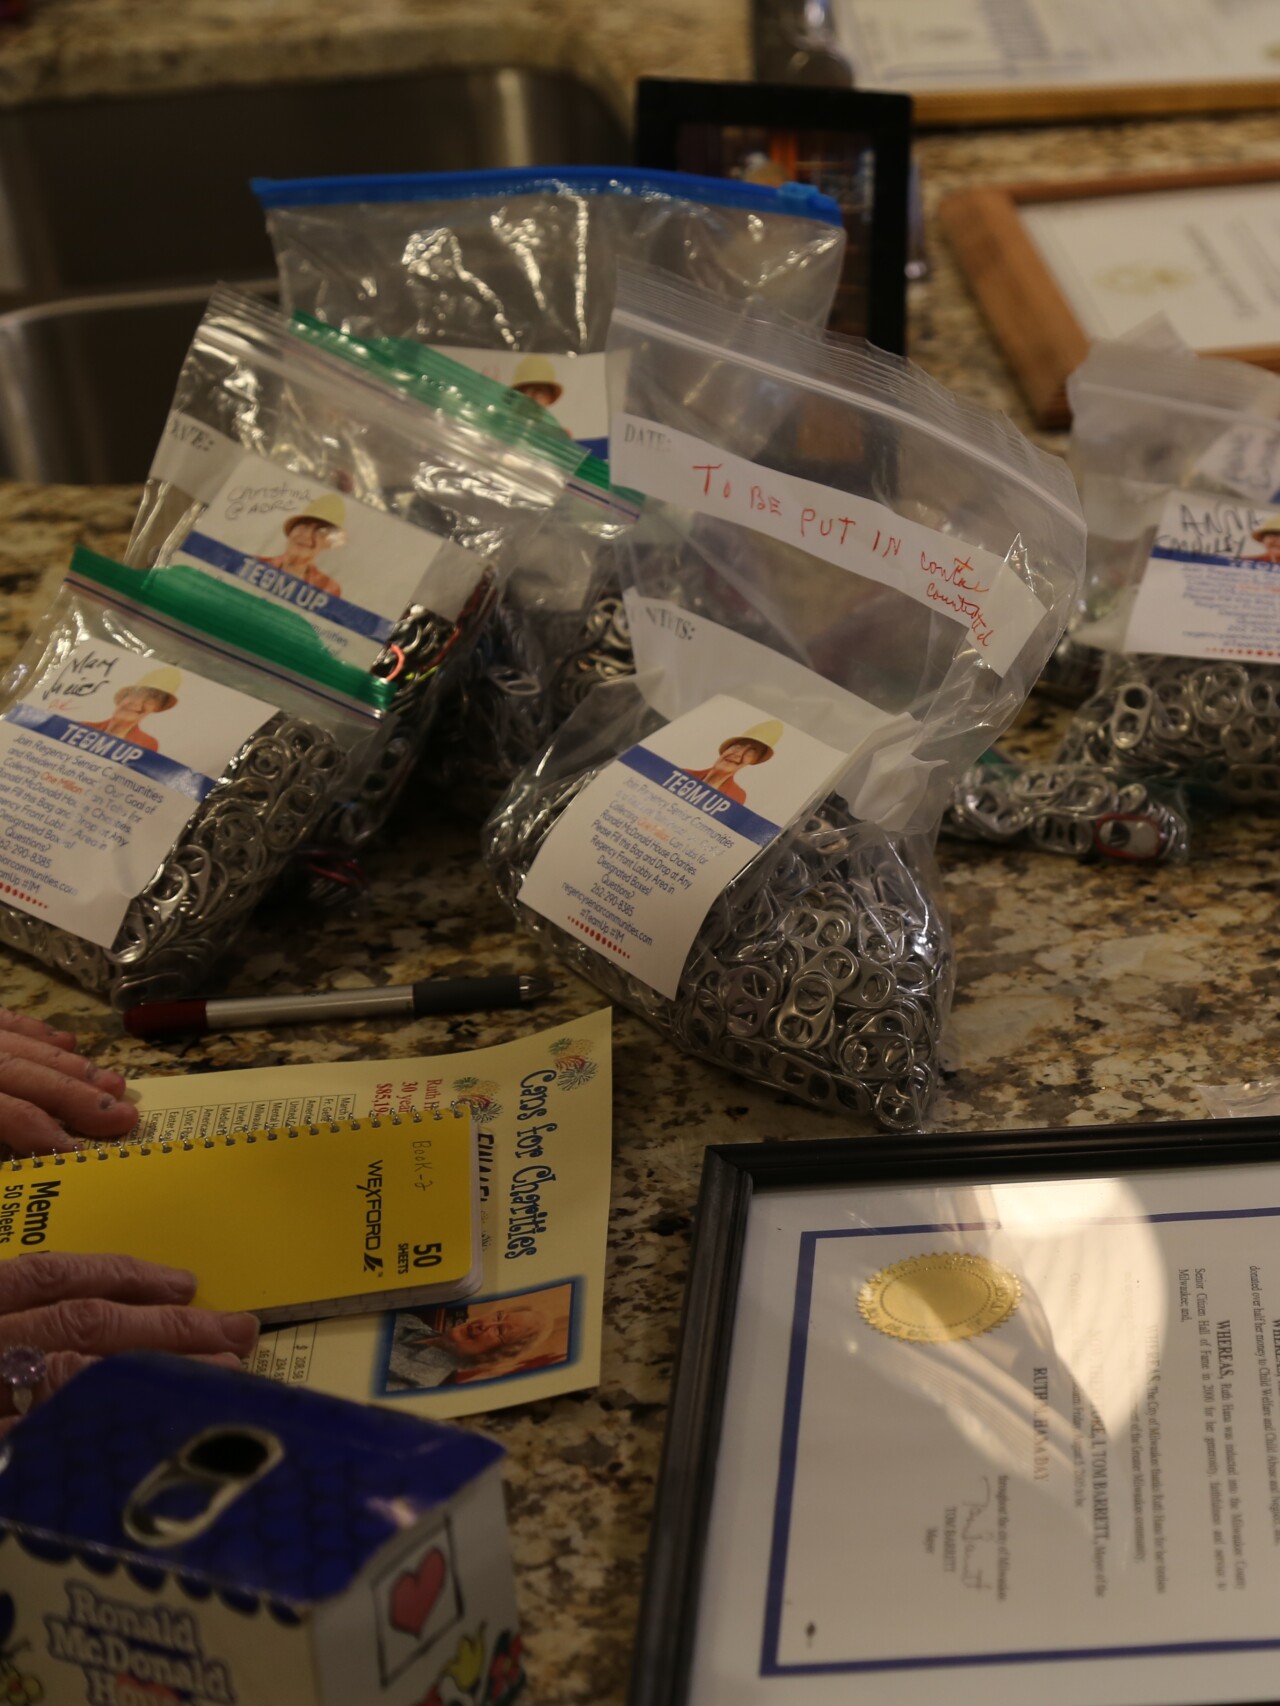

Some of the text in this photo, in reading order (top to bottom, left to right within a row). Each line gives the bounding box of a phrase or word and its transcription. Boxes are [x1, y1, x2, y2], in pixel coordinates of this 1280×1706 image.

[749, 485, 783, 517] BE
[800, 508, 856, 546] PUT
[872, 529, 903, 559] IN
[235, 558, 329, 611] TEAM UP
[32, 740, 102, 772] Regency Senior
[60, 724, 143, 763] TEAM UP
[3, 757, 83, 794] Collecting One Million
[662, 770, 731, 815] TEAM UP
[5, 826, 51, 852] Questions?
[593, 819, 692, 890] Please Fill this Bag and Drop at Any
[602, 809, 624, 828] Ronald
[622, 822, 653, 847] McDonald
[650, 842, 670, 858] House
[591, 834, 617, 859] Regency
[616, 851, 634, 868] Front
[632, 862, 652, 881] Lobby
[651, 874, 669, 891] Area
[597, 855, 653, 896] Designated Boxes!
[591, 883, 635, 917] 262-290-8385
[601, 873, 635, 900] Questions?
[565, 886, 653, 946] regencyseniorcommunities.com
[339, 1097, 351, 1115] March
[401, 1082, 417, 1092] 30
[425, 1079, 442, 1100] Ruth
[504, 1069, 558, 1259] Cans for Charities
[0, 1184, 24, 1244] 50 Sheets
[20, 1180, 61, 1245] Memo
[356, 1160, 383, 1251] WEXFORD
[398, 1243, 409, 1274] SHEETS
[413, 1243, 442, 1268] 50
[1217, 1320, 1234, 1379] WHEREAS,
[70, 1582, 194, 1650] Ronald
[48, 1619, 229, 1697] McDonald
